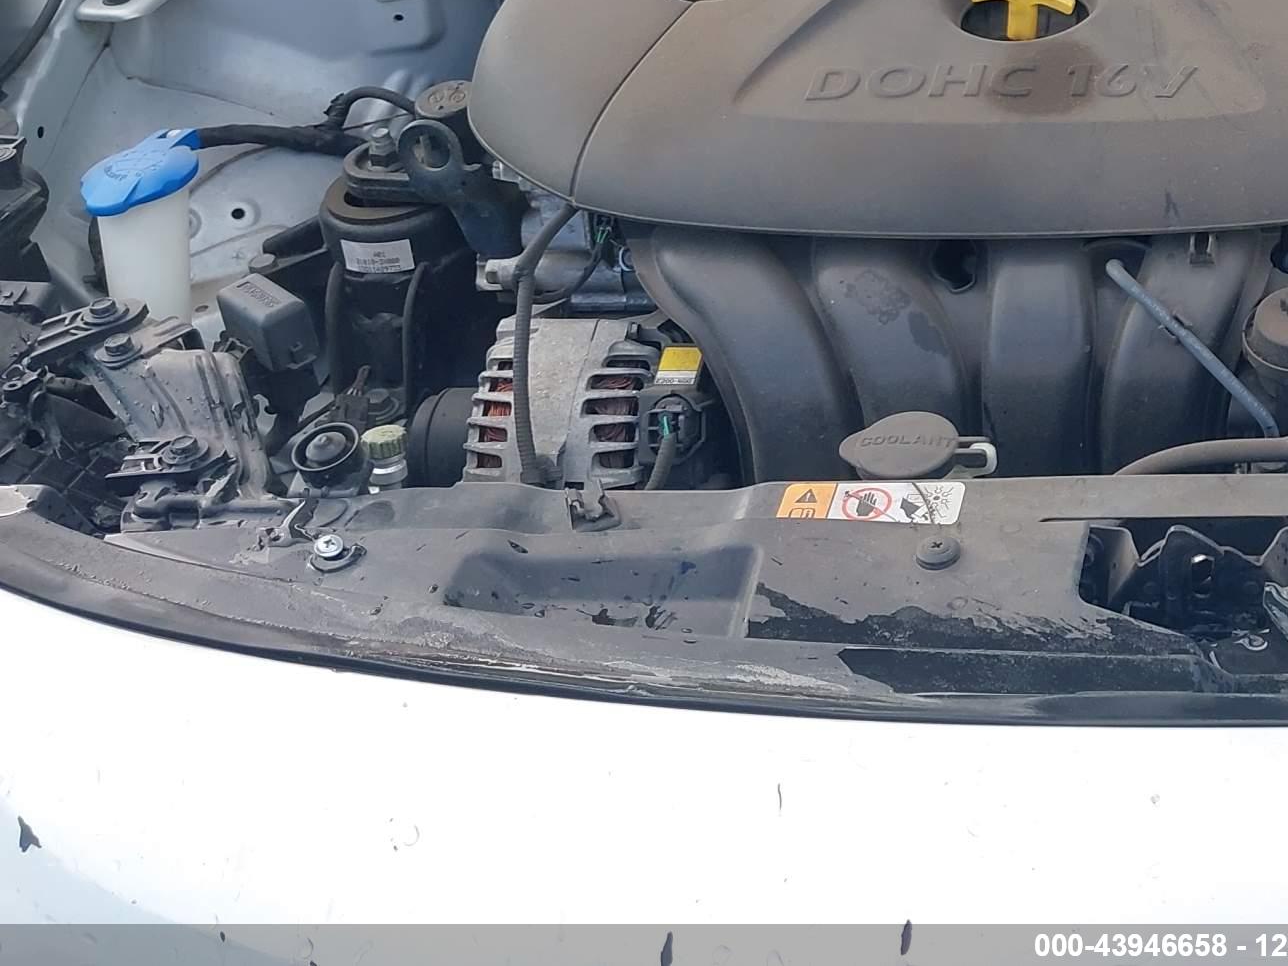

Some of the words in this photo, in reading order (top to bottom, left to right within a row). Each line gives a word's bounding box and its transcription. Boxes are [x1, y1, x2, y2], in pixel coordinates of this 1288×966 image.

[805, 65, 1039, 101] DOHC
[1066, 65, 1198, 99] 16V
[858, 433, 959, 448] COOLANT
